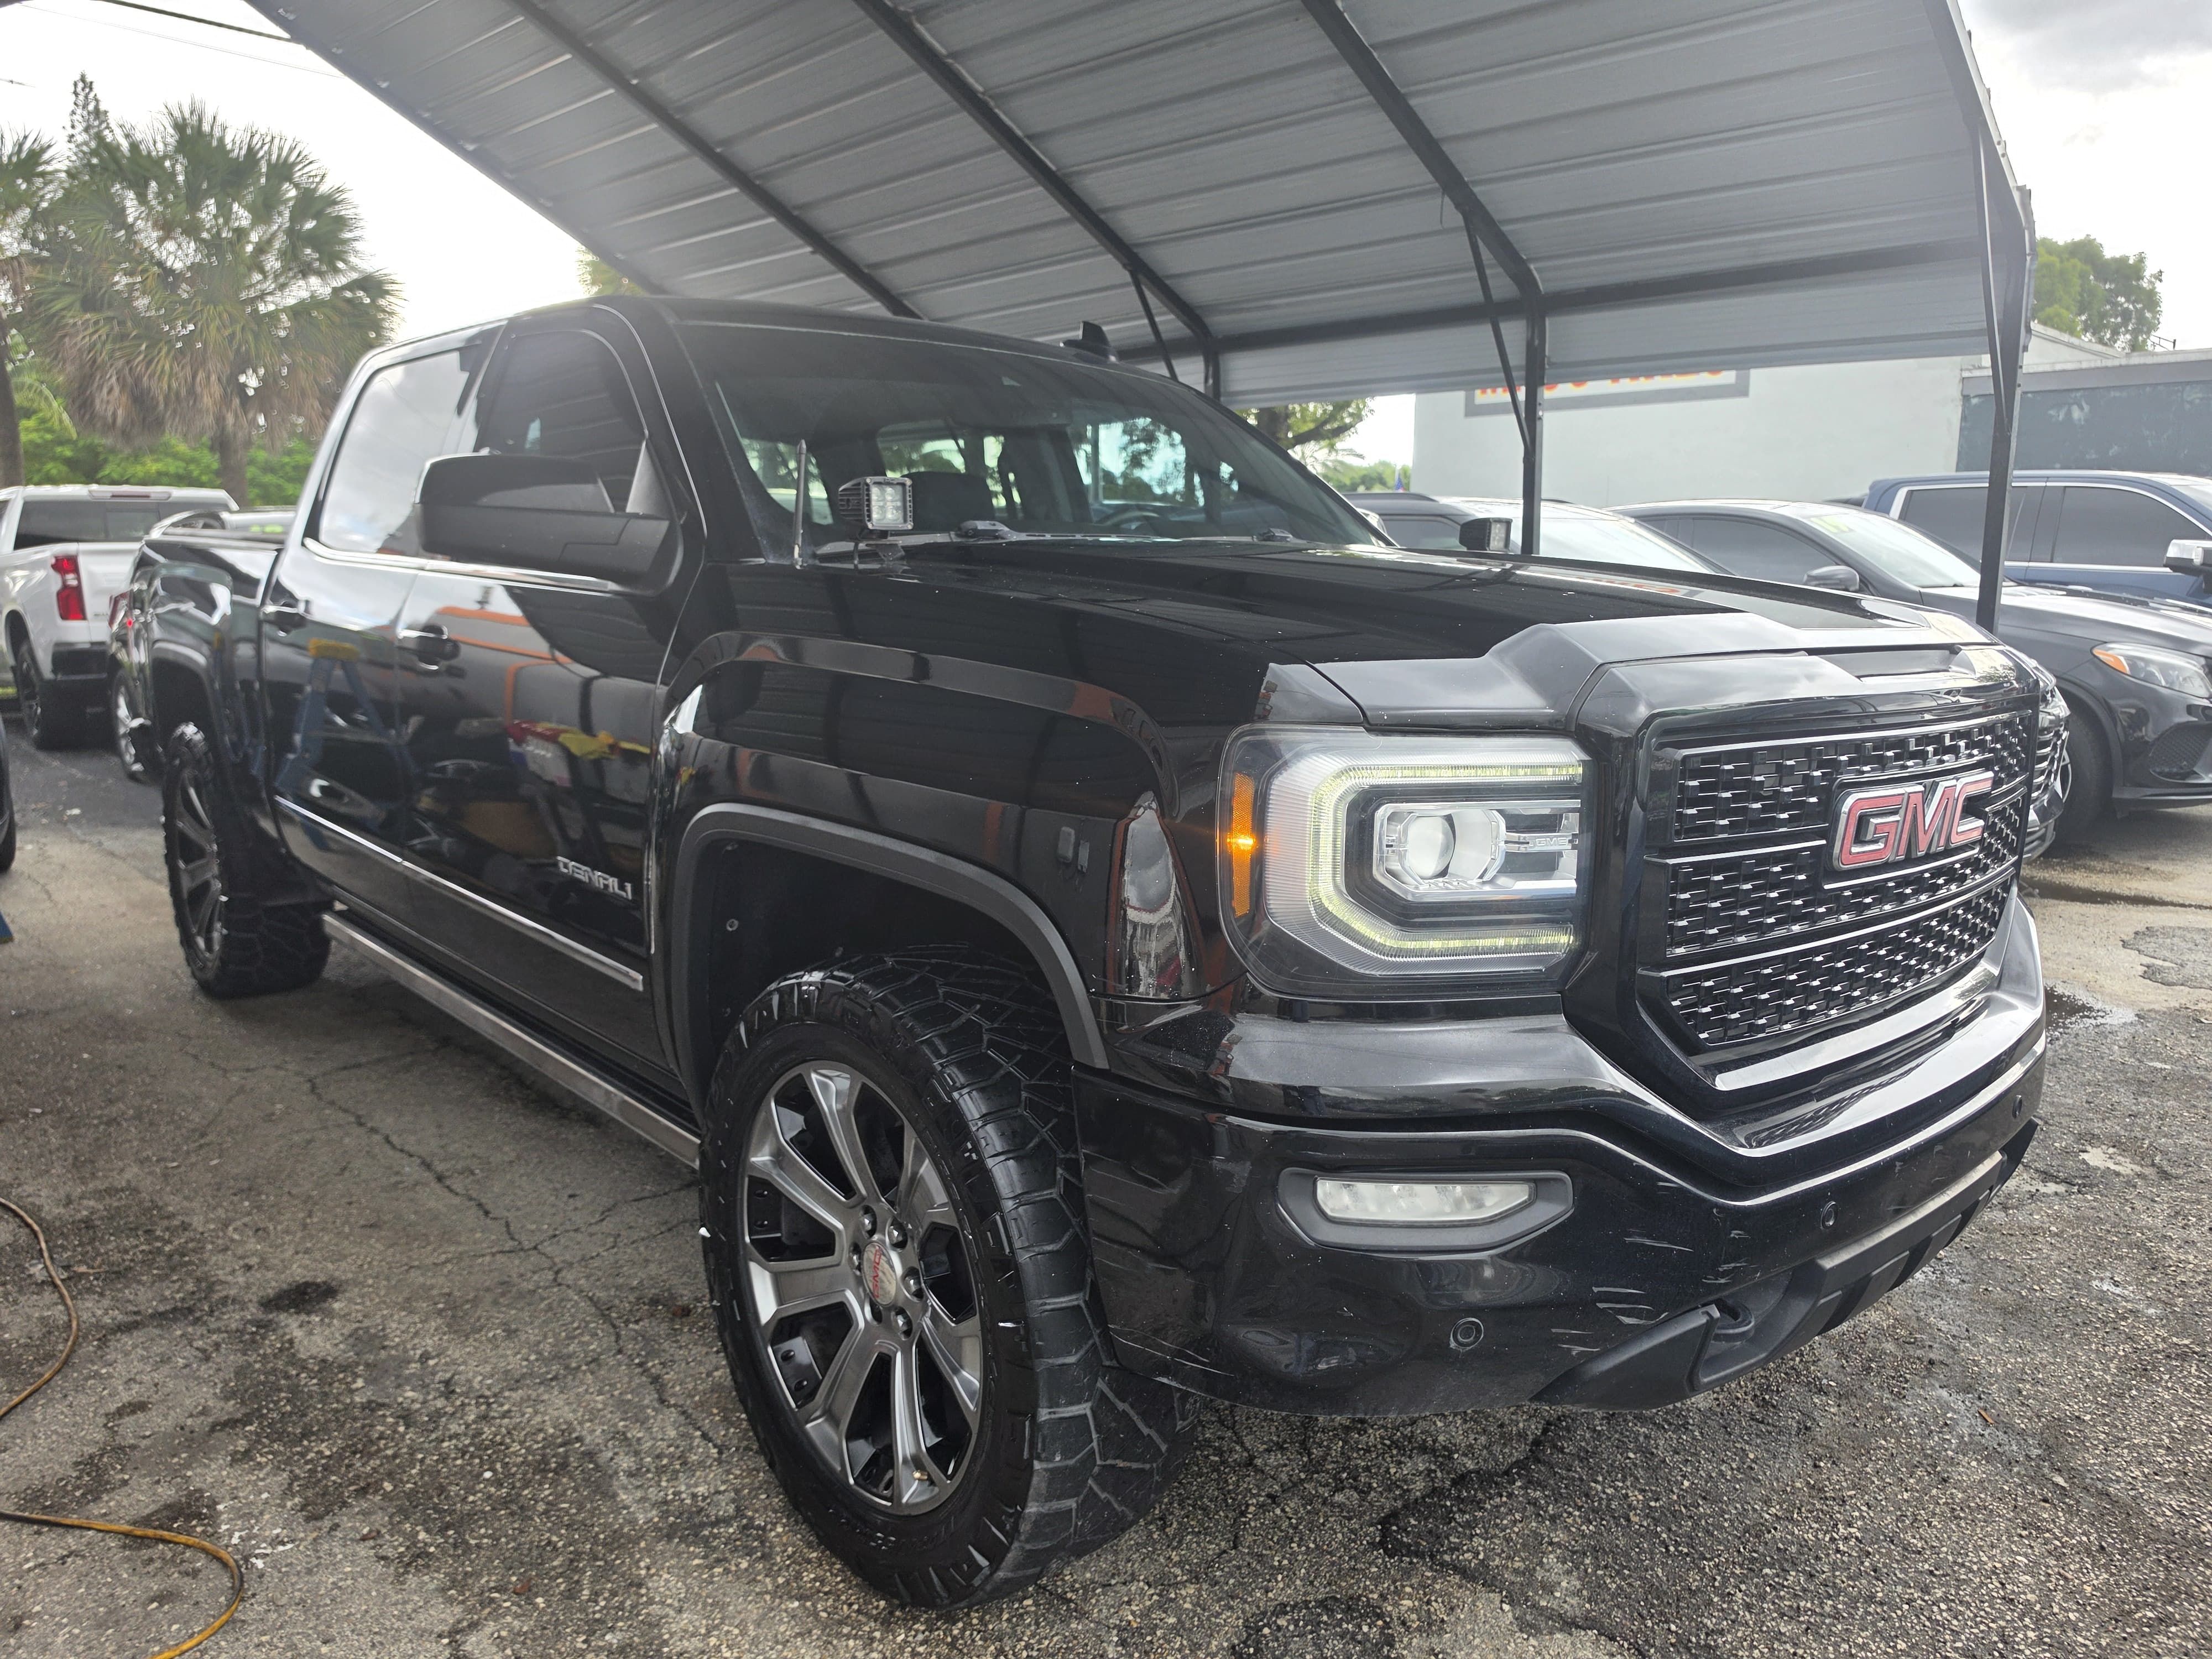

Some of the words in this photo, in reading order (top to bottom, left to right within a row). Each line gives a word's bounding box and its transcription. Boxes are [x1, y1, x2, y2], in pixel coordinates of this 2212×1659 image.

[1832, 770, 1995, 871] GMC
[556, 855, 632, 900] DENALI
[871, 1245, 882, 1299] GMC
